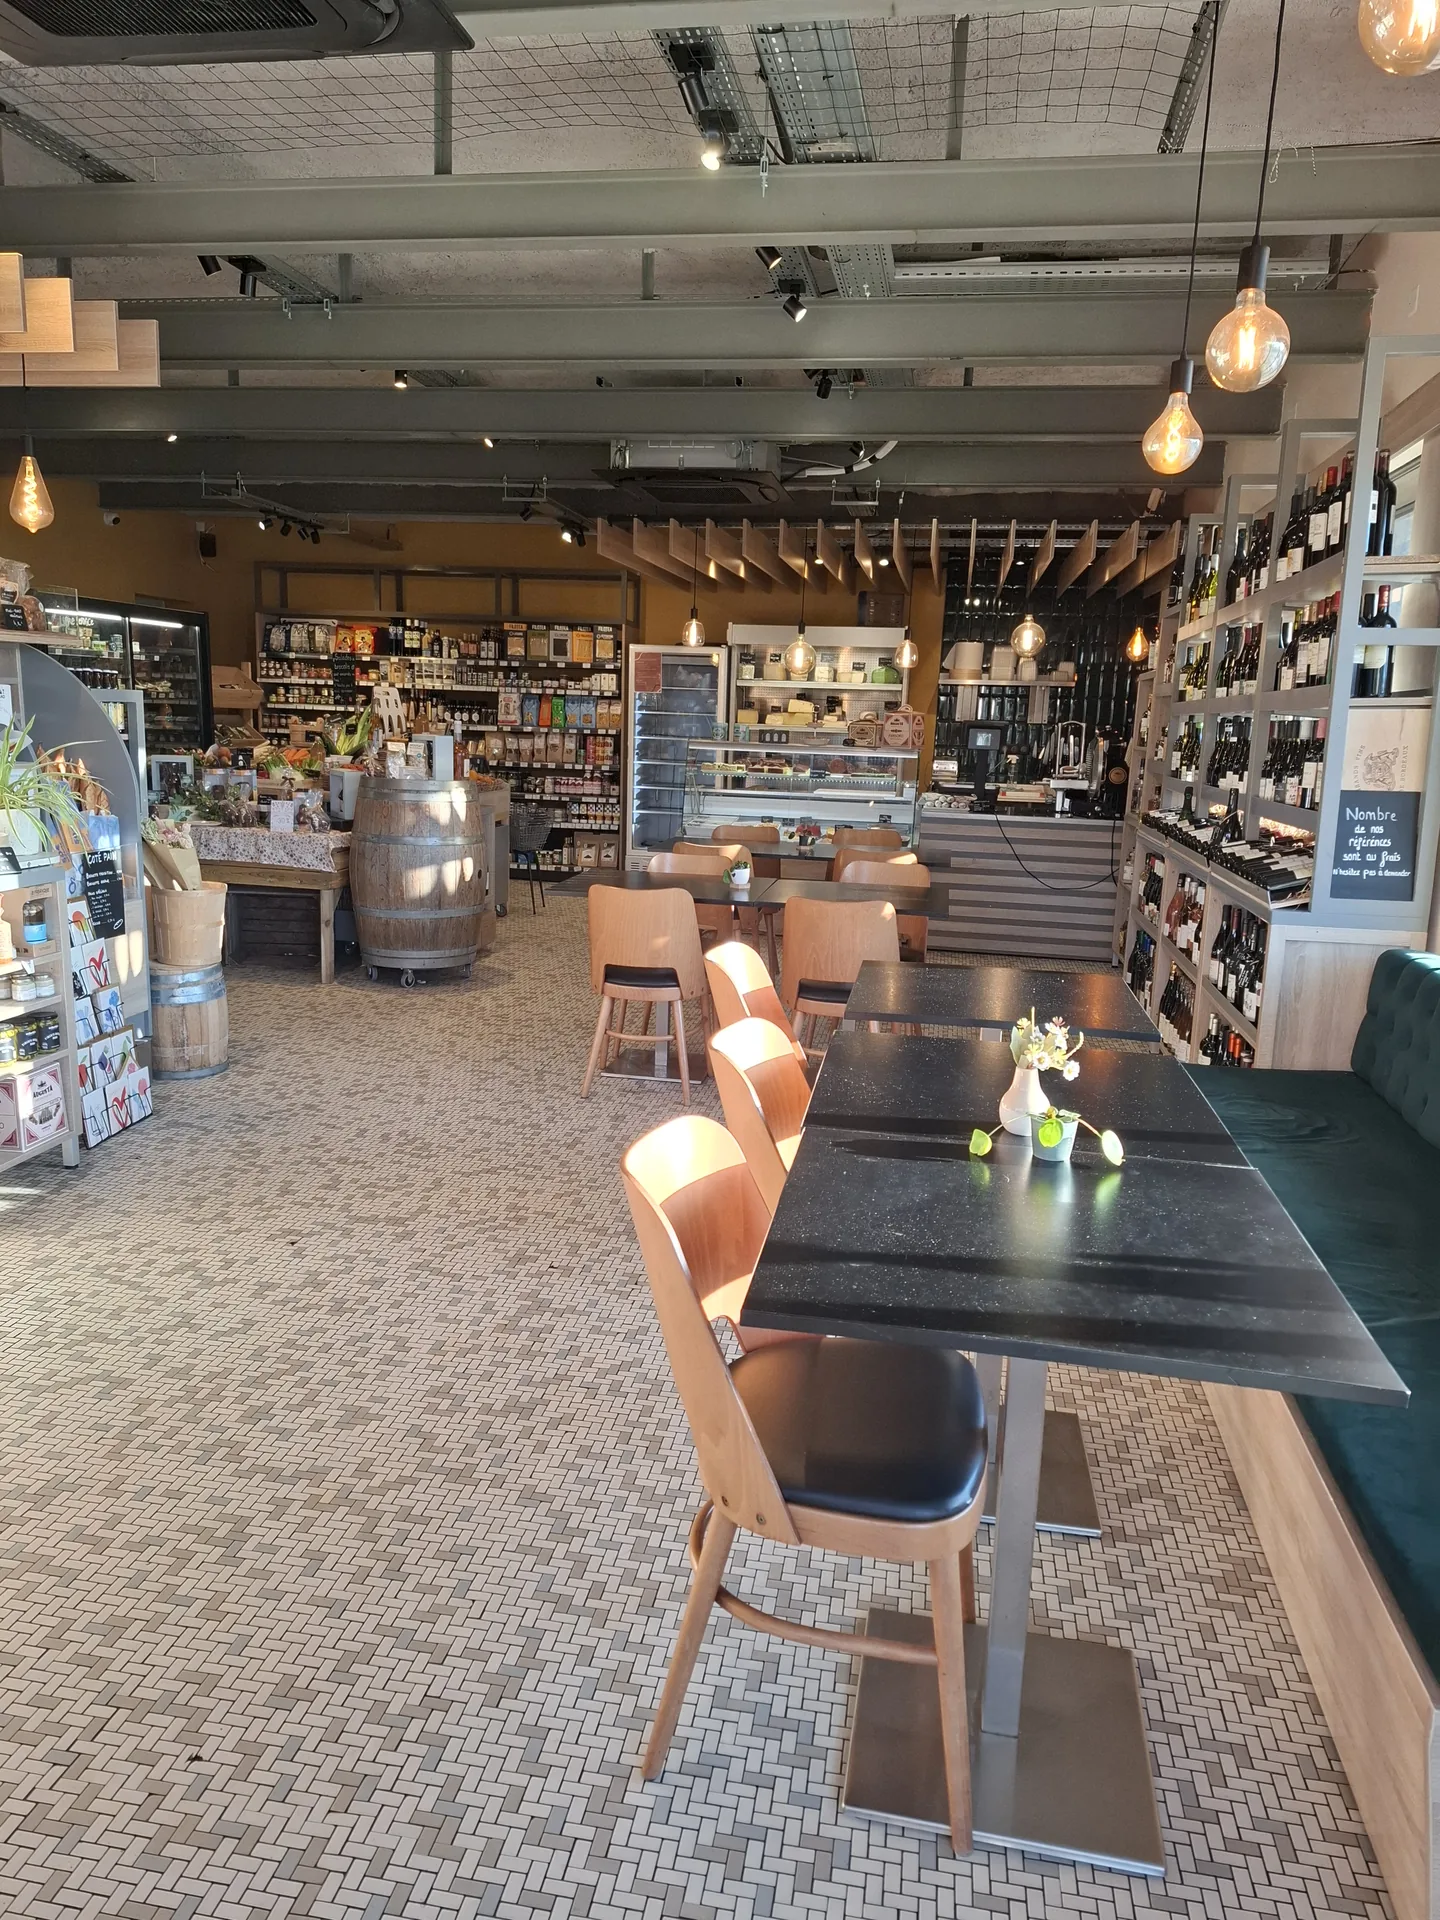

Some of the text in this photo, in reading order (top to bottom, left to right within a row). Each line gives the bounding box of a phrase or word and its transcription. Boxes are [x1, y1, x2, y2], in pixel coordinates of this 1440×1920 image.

[1353, 744, 1366, 790] RANDS VINS
[1399, 745, 1409, 782] BORDEAUX
[1345, 806, 1398, 821] Nombre
[1354, 824, 1384, 834] de nos
[1342, 851, 1362, 861] sont
[1379, 851, 1401, 867] frais
[1363, 869, 1377, 880] pas
